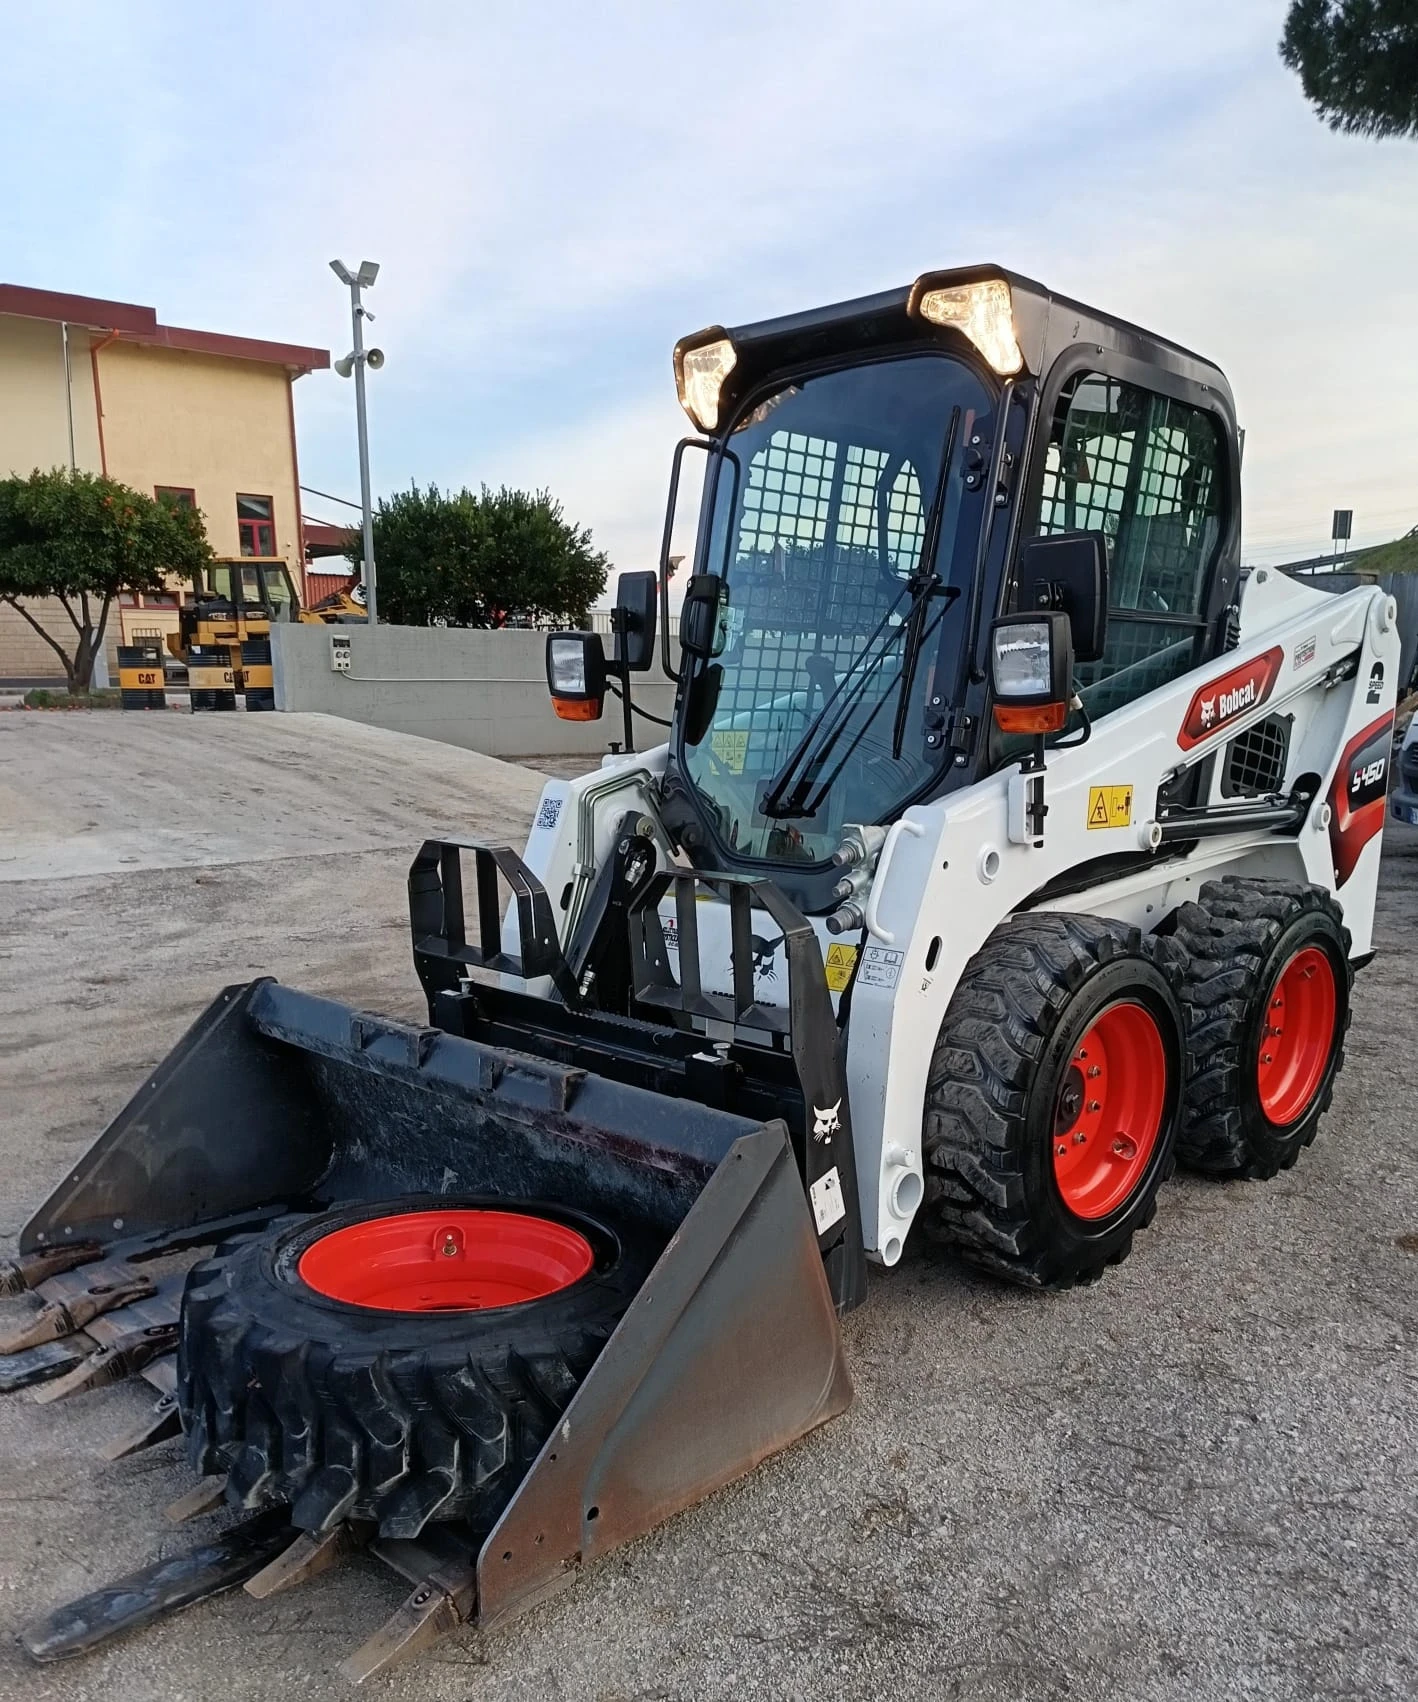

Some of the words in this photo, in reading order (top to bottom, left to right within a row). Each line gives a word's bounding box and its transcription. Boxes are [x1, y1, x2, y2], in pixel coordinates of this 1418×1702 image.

[138, 673, 155, 684] CAT
[1220, 677, 1255, 719] Bobcat
[1352, 757, 1385, 792] S450
